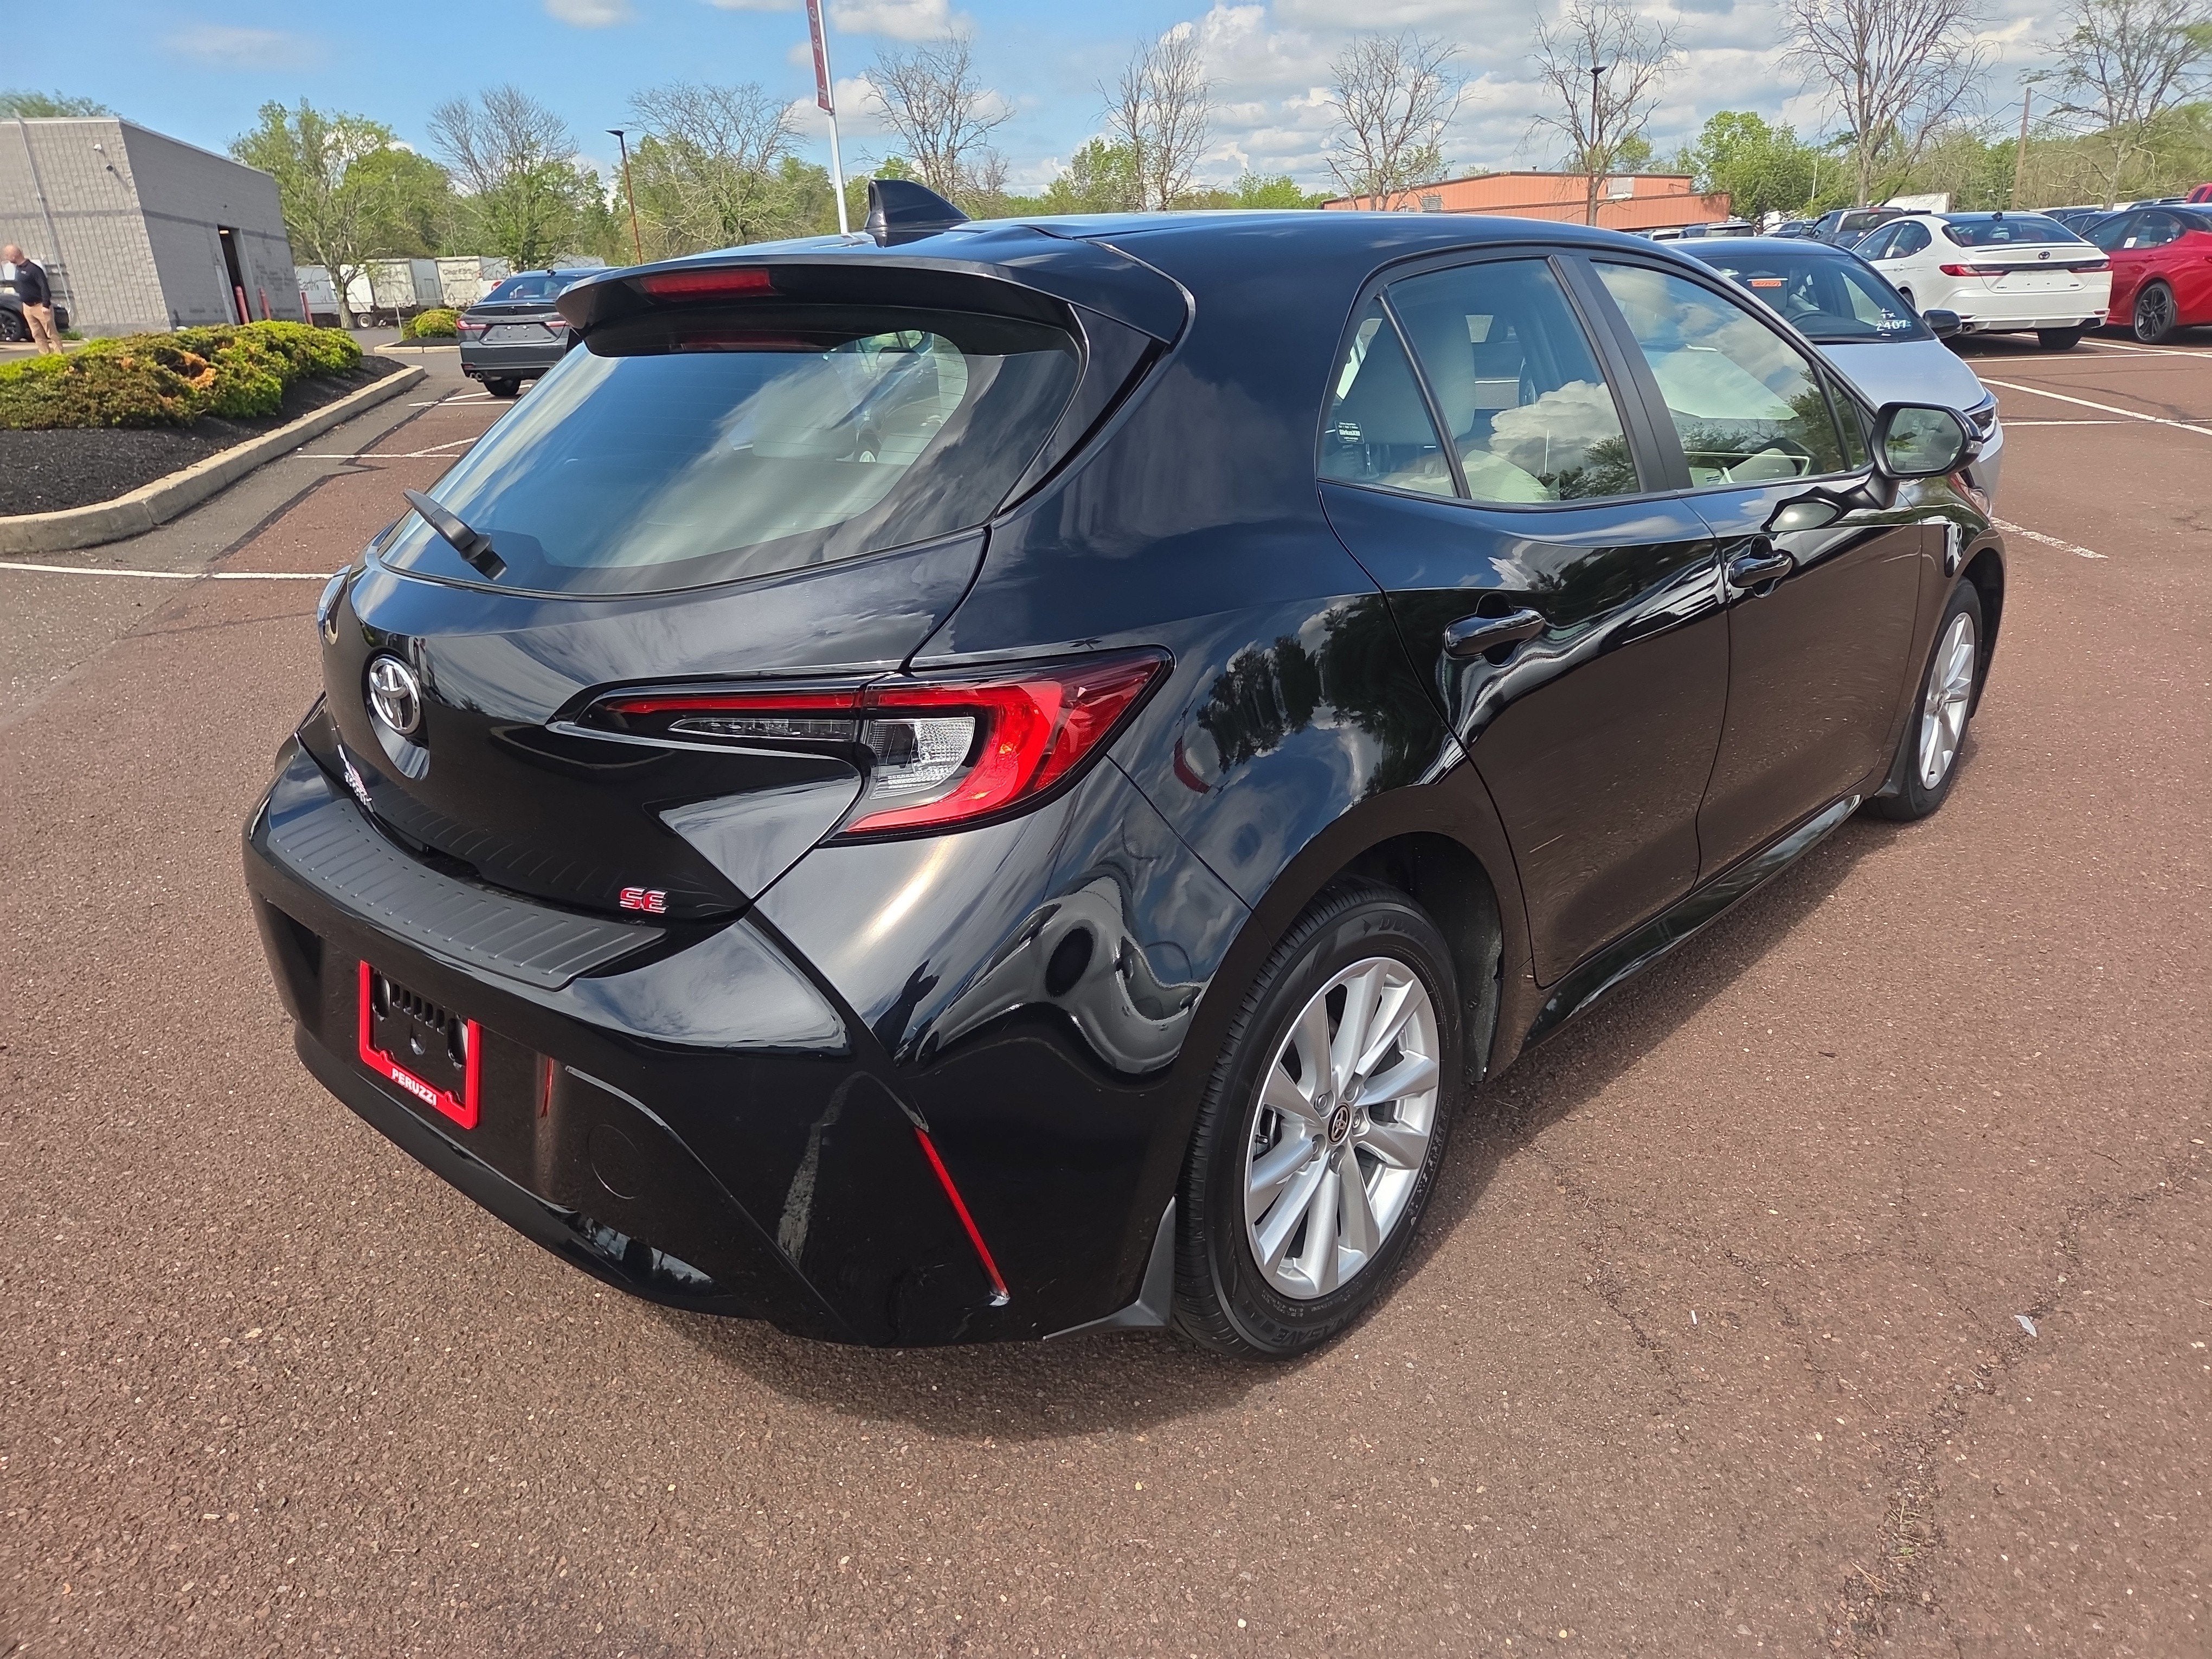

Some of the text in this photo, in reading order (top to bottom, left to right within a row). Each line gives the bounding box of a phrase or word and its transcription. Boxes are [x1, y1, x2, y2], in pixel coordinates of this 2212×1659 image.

[1876, 320, 1906, 331] 2407
[619, 886, 667, 914] SE
[392, 1068, 437, 1107] PERUZZI
